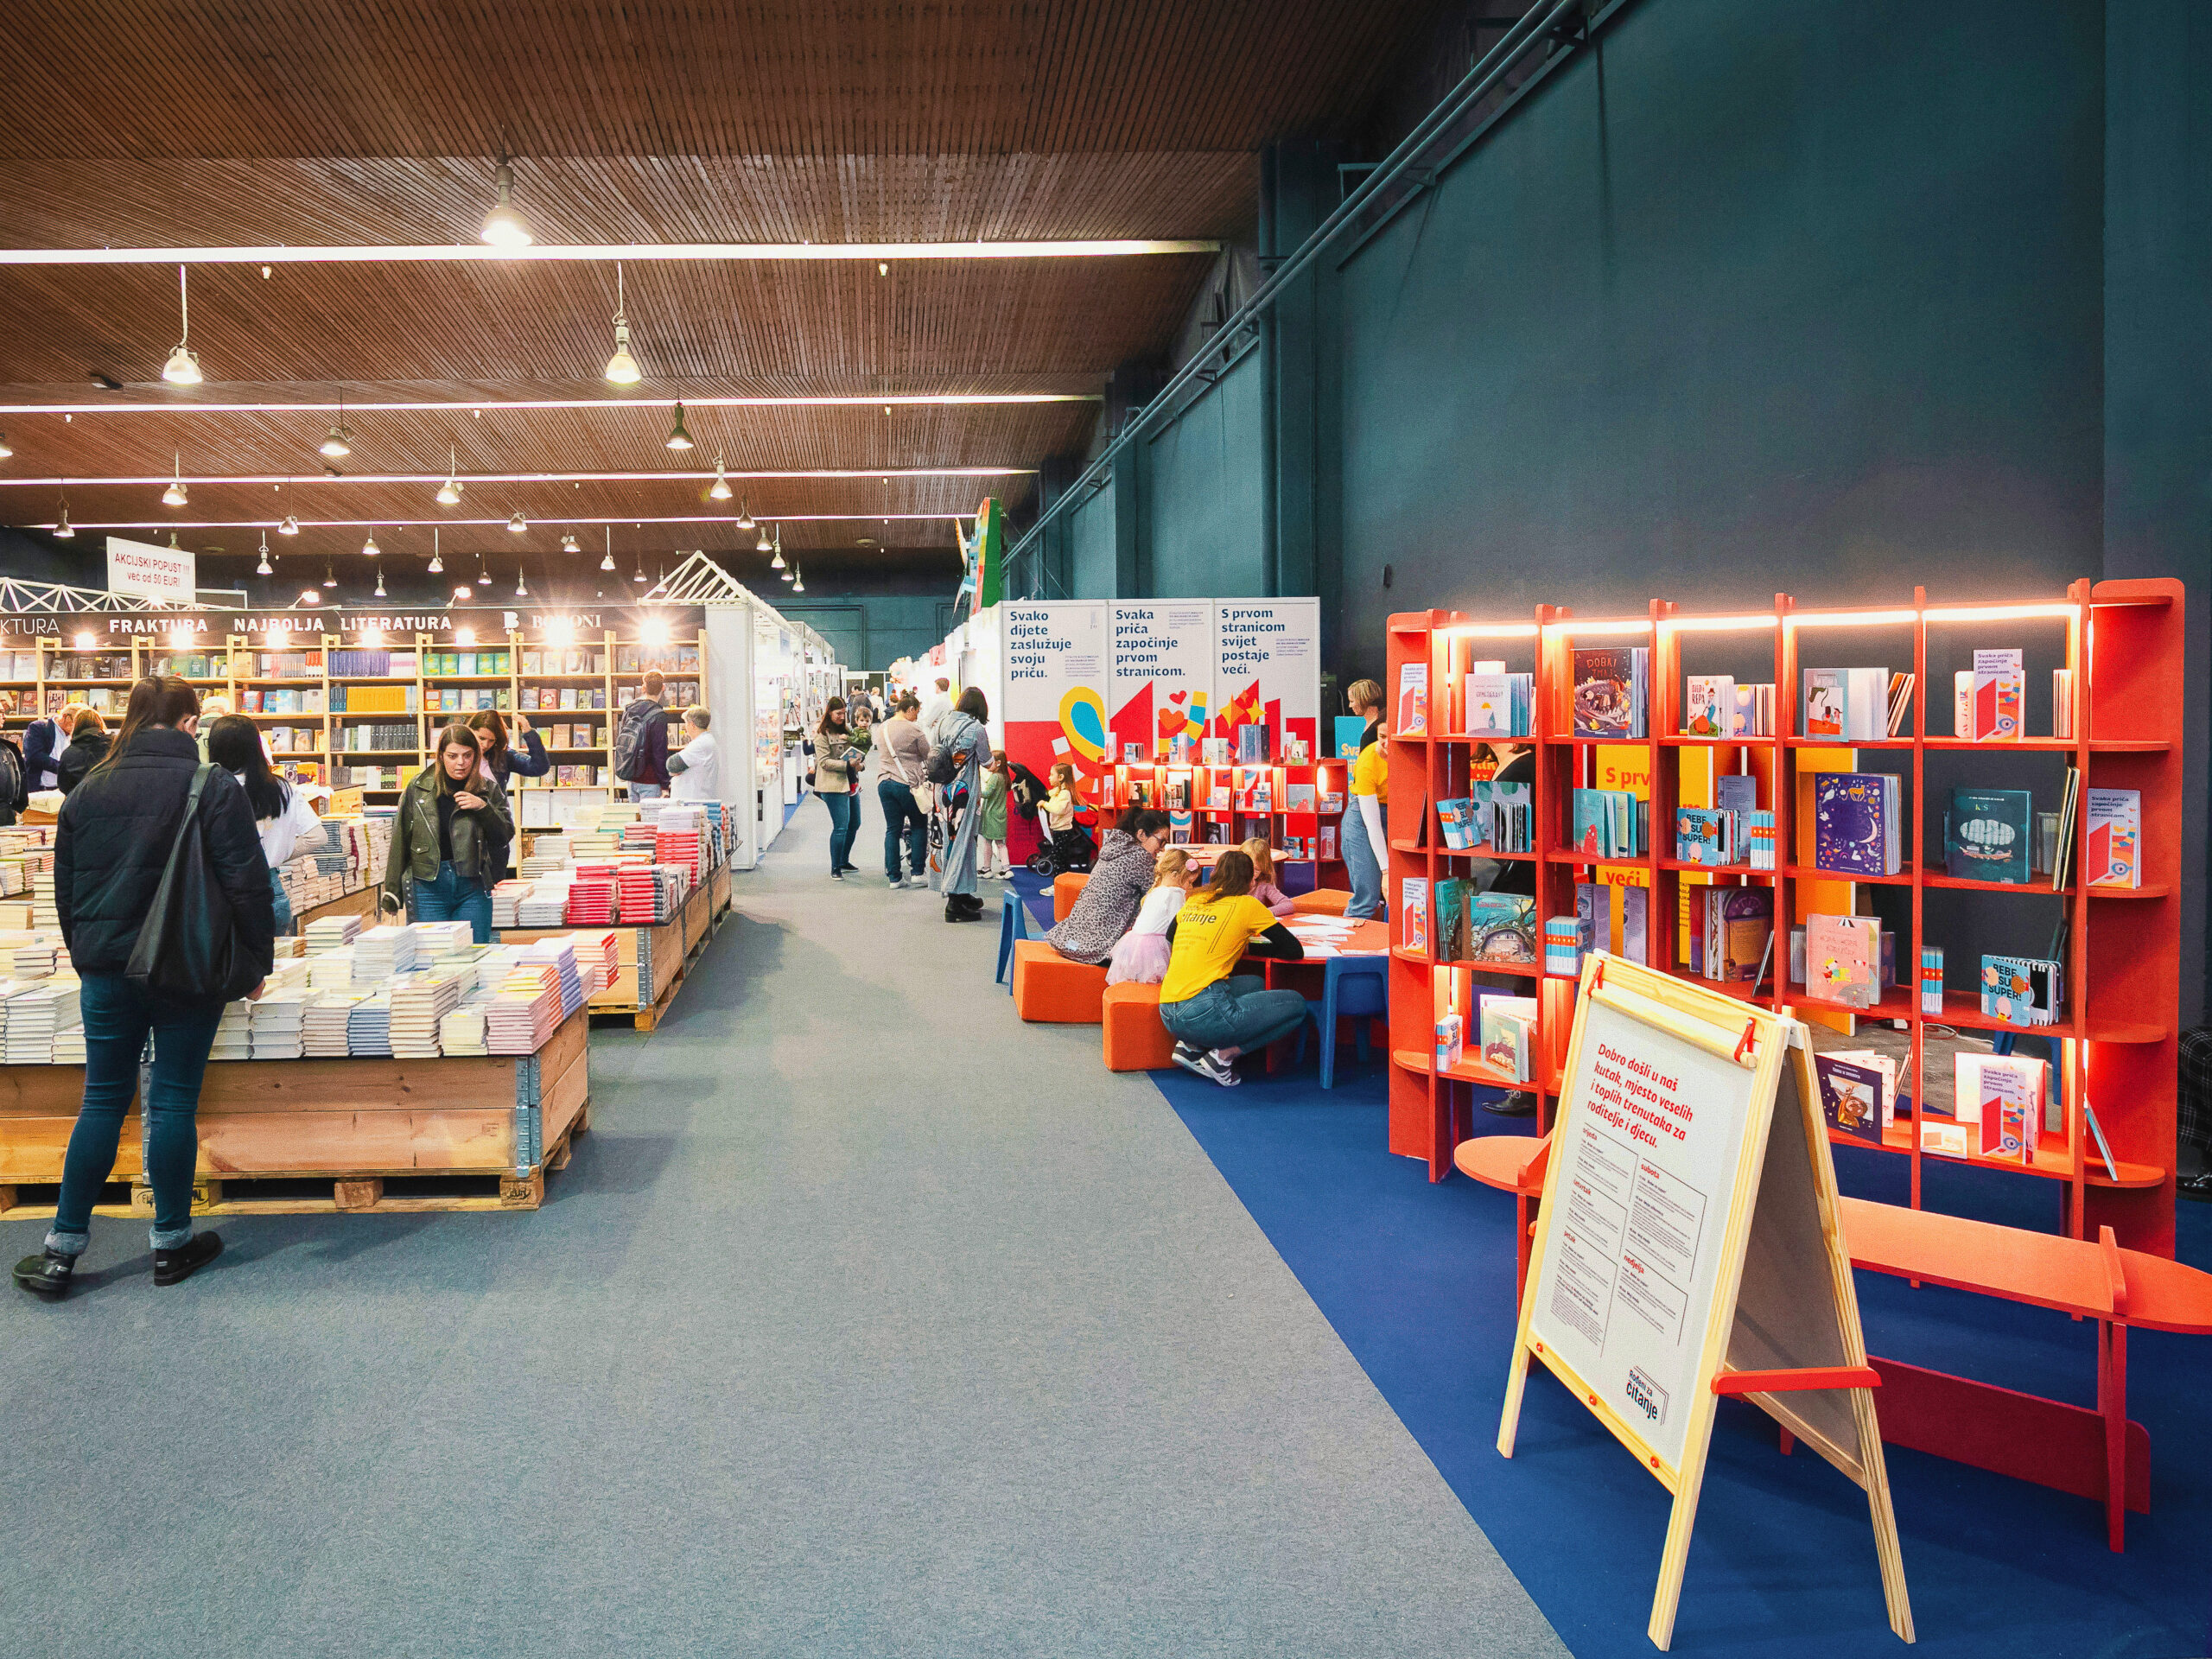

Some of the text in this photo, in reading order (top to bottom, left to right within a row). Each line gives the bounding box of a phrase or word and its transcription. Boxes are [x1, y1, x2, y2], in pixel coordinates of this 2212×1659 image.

[115, 553, 151, 569] AKCIJSKI
[153, 559, 181, 574] POPUST
[143, 573, 151, 583] od
[154, 574, 162, 584] 50
[532, 614, 601, 629] BOONI
[1010, 610, 1049, 621] Svako
[1116, 609, 1154, 620] Svaka
[1221, 608, 1274, 621] S prvom
[109, 615, 452, 633] FRAKTURA NAJBOLJA LITERATURA
[1010, 624, 1048, 638] dijete
[1116, 623, 1148, 637] priča
[1221, 621, 1286, 632] stranicom
[1010, 638, 1072, 652] zaslužuje
[1116, 637, 1179, 651] započinje
[1222, 635, 1257, 649] svijet
[1010, 652, 1046, 667] svoju
[1116, 654, 1158, 665] prvom
[1222, 649, 1270, 664] postaje
[1011, 667, 1048, 681] priču.
[1116, 665, 1185, 677] stranicom.
[1222, 663, 1250, 675] veći.
[1605, 766, 1616, 784] S
[1686, 814, 1707, 824] BEBE
[1691, 823, 1702, 833] SU
[1682, 834, 1711, 845] SUPER!
[1179, 912, 1217, 925] itanje
[1993, 963, 2018, 976] BEBE
[1998, 976, 2012, 987] SU
[1988, 985, 2022, 1001] SUPER!
[1598, 1043, 1679, 1092] Dobro došli u naš
[1594, 1060, 1694, 1122] kutak, mjesto veselih
[1590, 1078, 1687, 1141] i toplih trenutaka za
[1587, 1100, 1657, 1148] roditelje i djecu.
[1641, 1164, 1660, 1179] subota
[1646, 1386, 1653, 1397] za
[1626, 1379, 1658, 1420] čitanje
